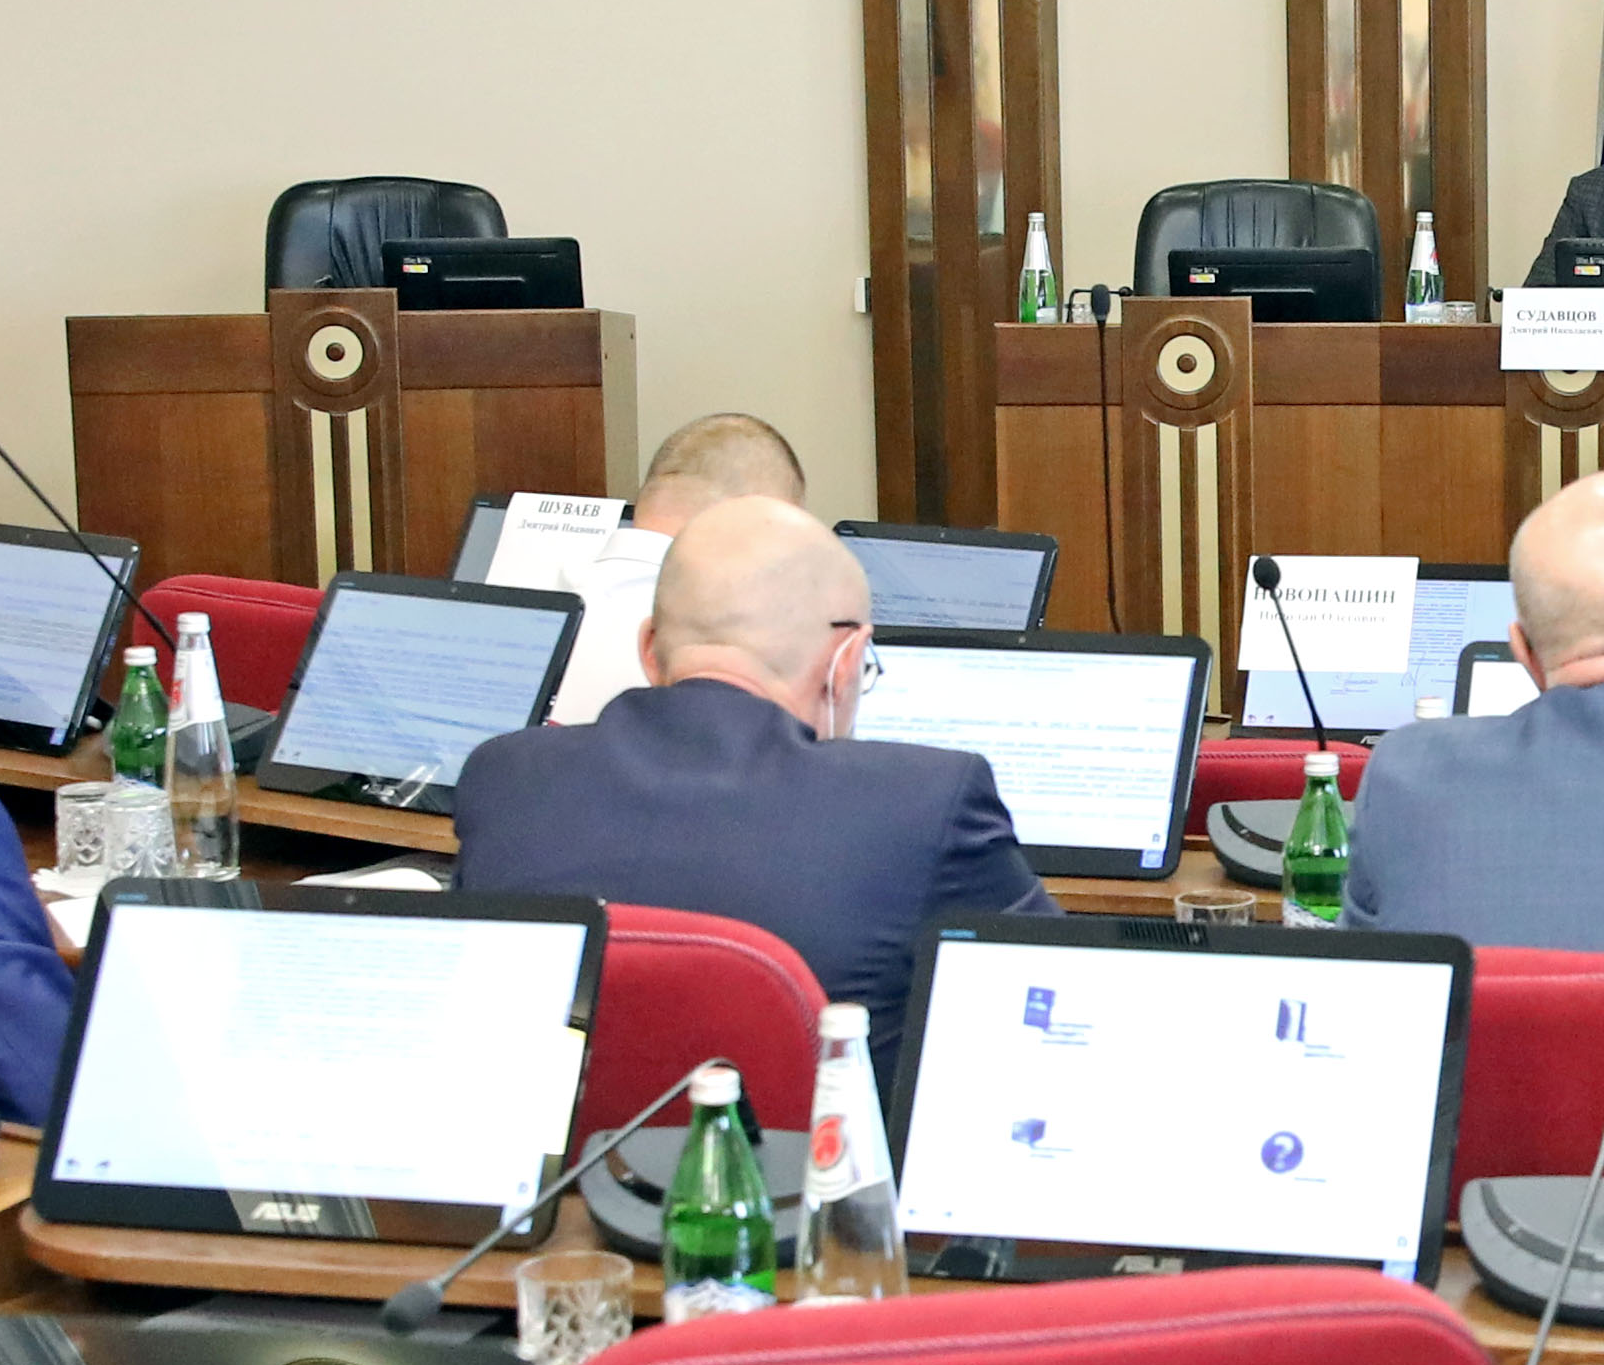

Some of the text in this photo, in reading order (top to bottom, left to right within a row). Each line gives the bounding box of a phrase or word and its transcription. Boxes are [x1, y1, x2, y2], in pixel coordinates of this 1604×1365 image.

[1516, 309, 1597, 323] СУДАВЦОВ
[538, 499, 602, 518] ШУВАЕВ
[250, 1201, 321, 1225] ASUS
